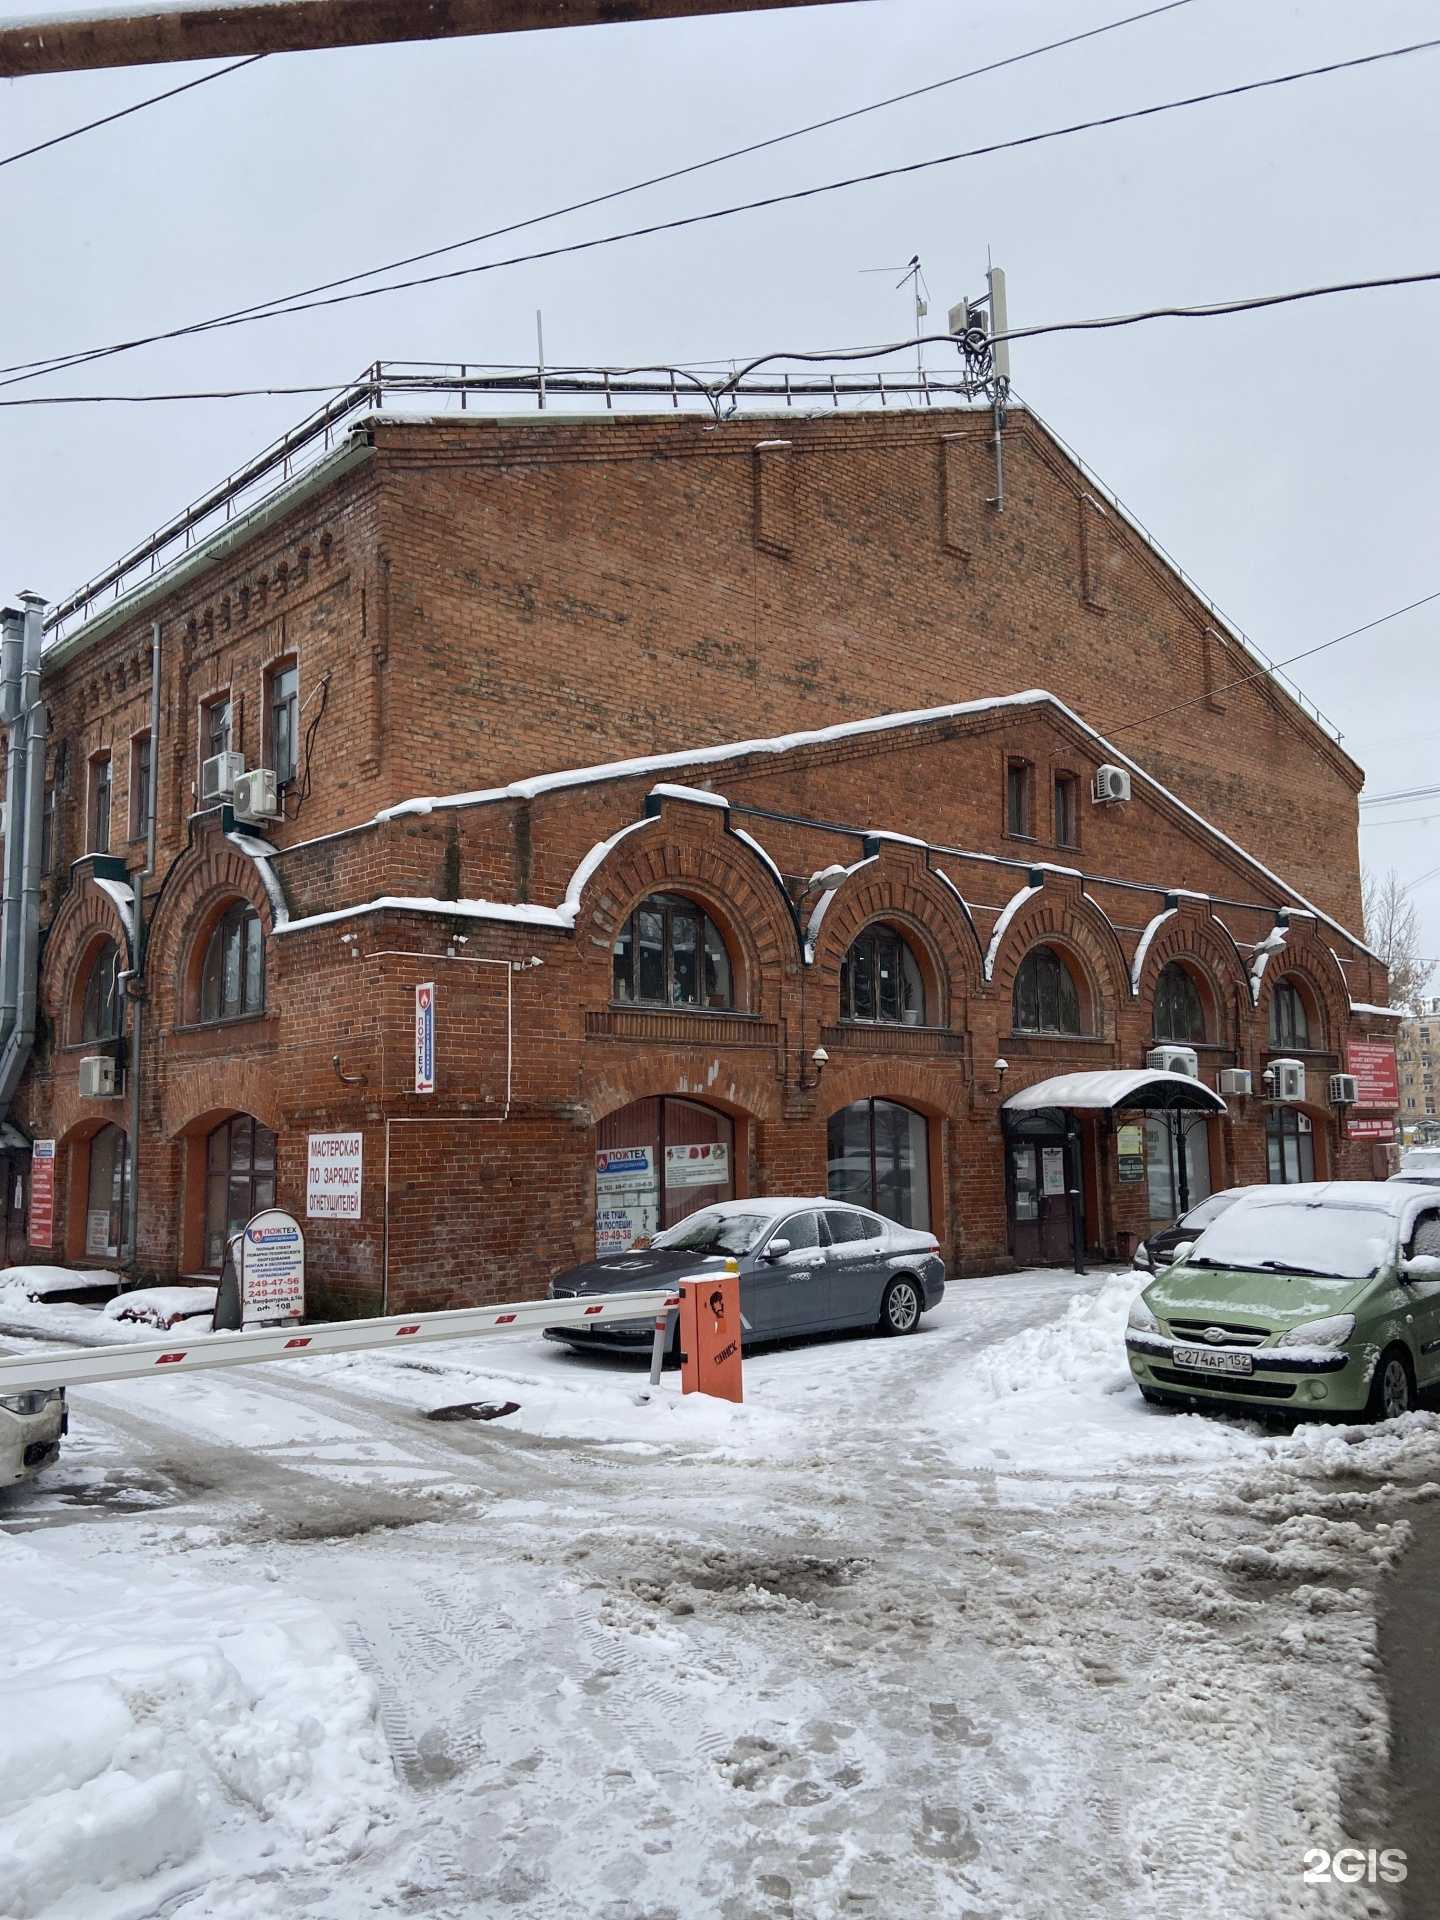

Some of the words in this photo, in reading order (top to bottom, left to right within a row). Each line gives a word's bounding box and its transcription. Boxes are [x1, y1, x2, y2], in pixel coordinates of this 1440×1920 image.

[310, 1139, 359, 1157] МАСТЕРСКАЯ
[609, 1149, 646, 1161] ПОЖТЕХ
[309, 1167, 320, 1184] ПО
[324, 1167, 359, 1187] ЗАРЯДКЕ
[309, 1192, 359, 1212] ОГНЕТУШИТЕЛЕЙ
[602, 1210, 611, 1219] НЕ
[264, 1226, 297, 1236] ПОЖТЕХ
[248, 1277, 300, 1288] 249-47-56
[248, 1287, 299, 1298] 249-49-38
[1228, 1354, 1250, 1367] 152
